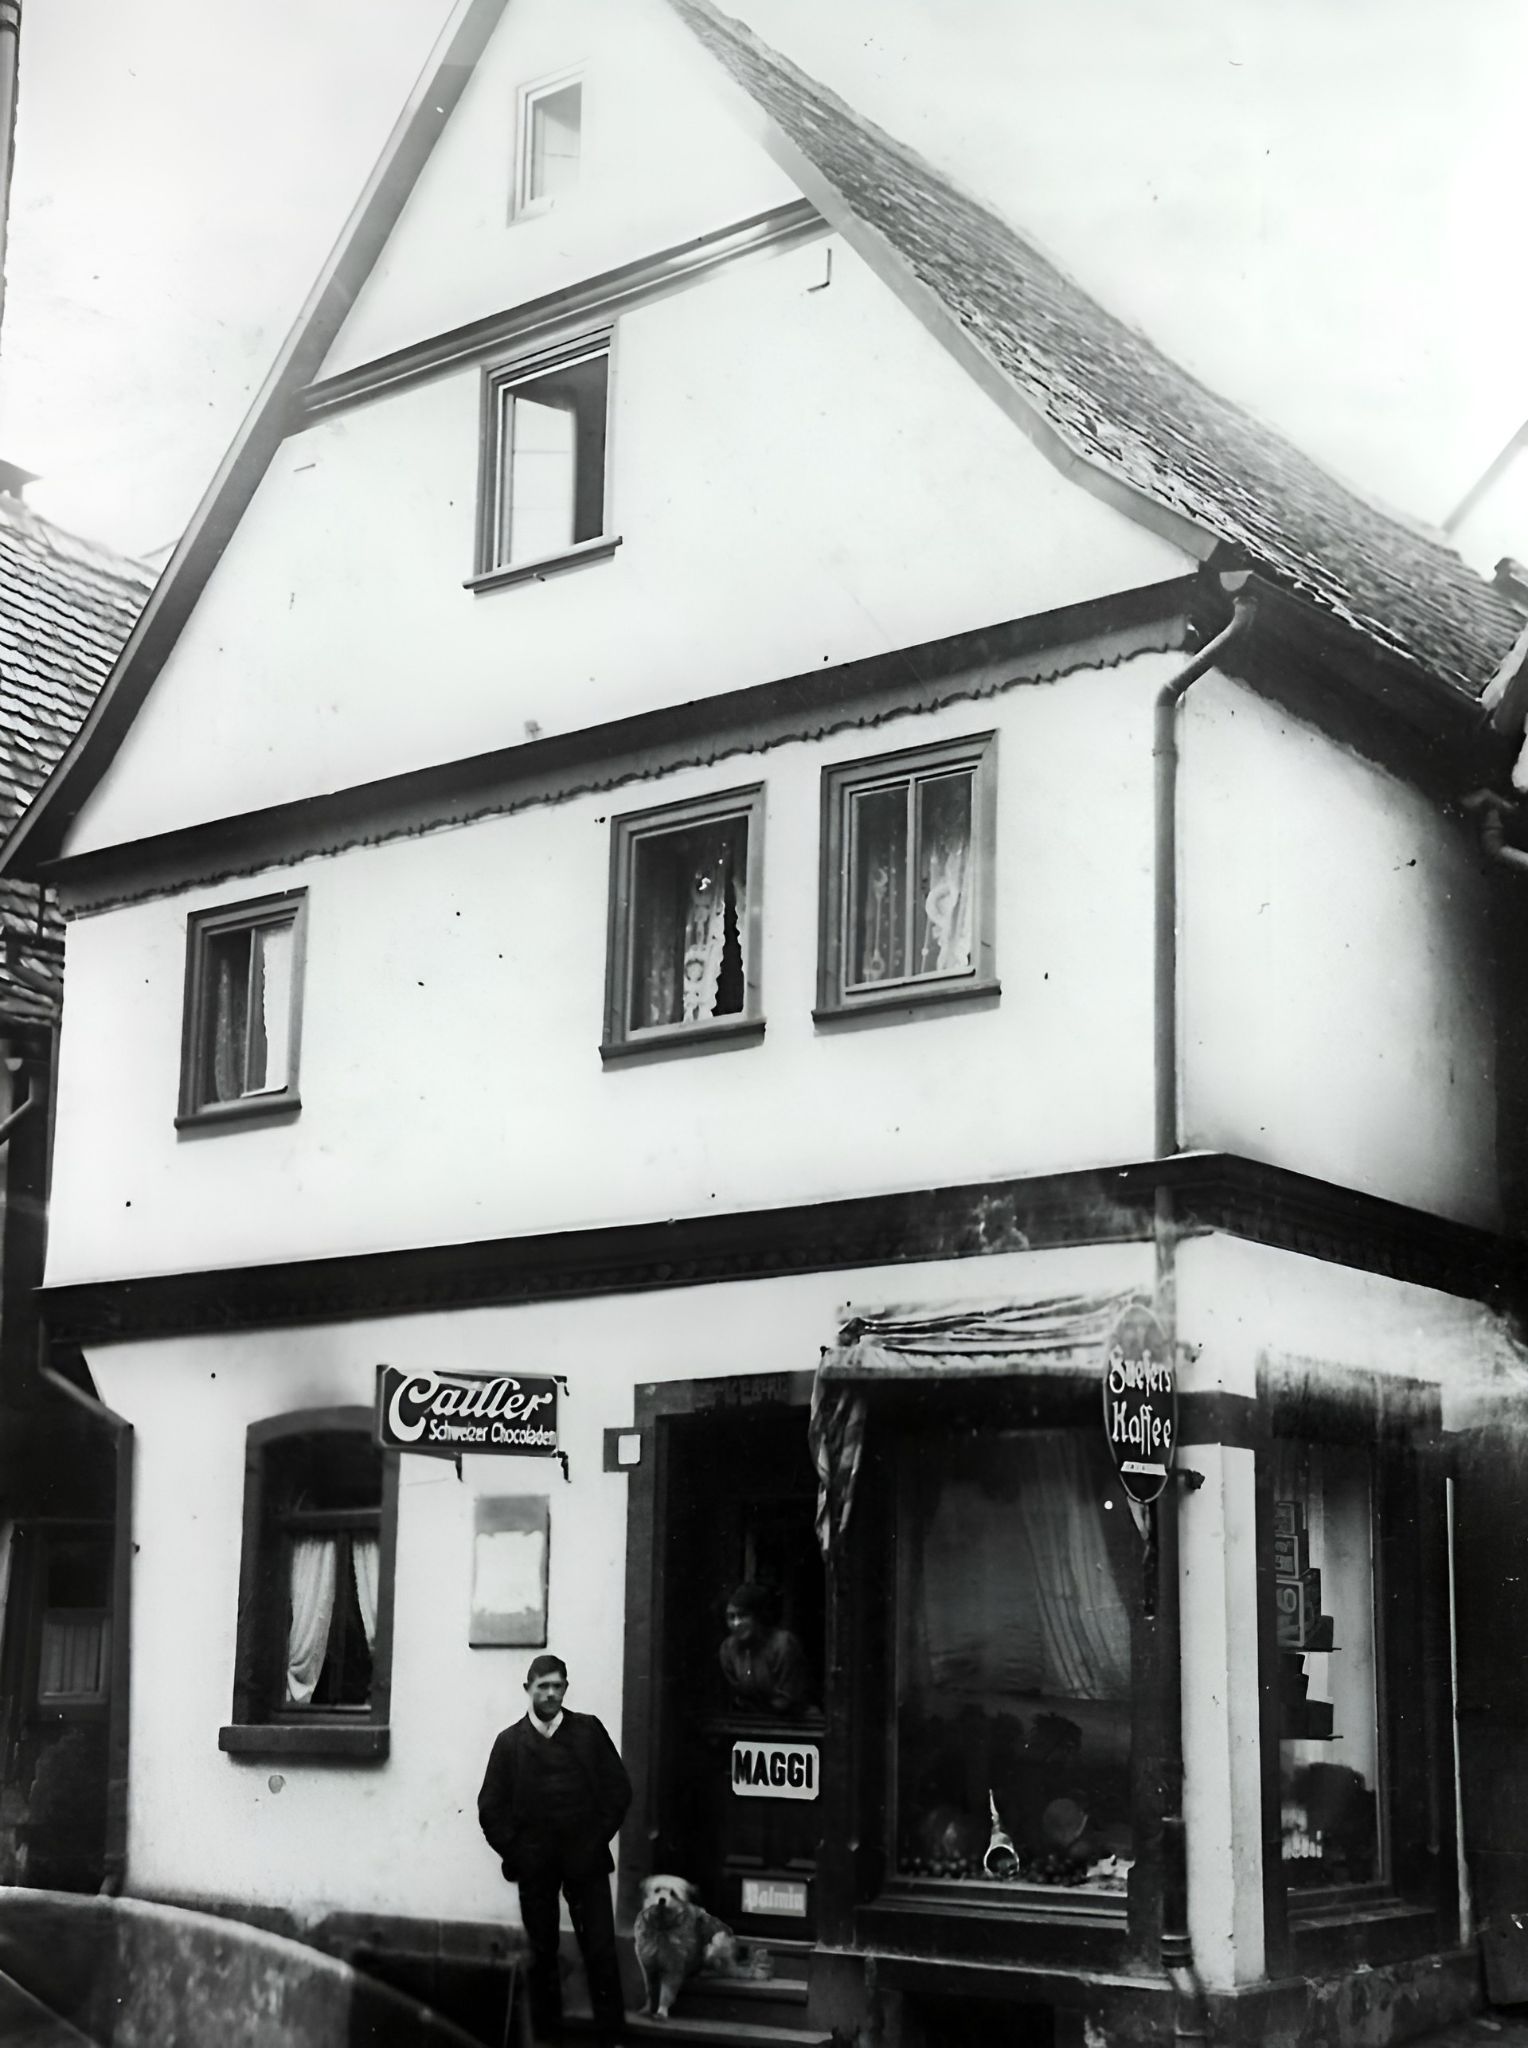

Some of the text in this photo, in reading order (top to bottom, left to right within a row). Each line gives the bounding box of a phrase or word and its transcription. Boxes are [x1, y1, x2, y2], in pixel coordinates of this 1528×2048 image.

[389, 1371, 553, 1442] Cailler
[1112, 1401, 1172, 1456] Kaffee
[733, 1749, 814, 1790] MAGGI
